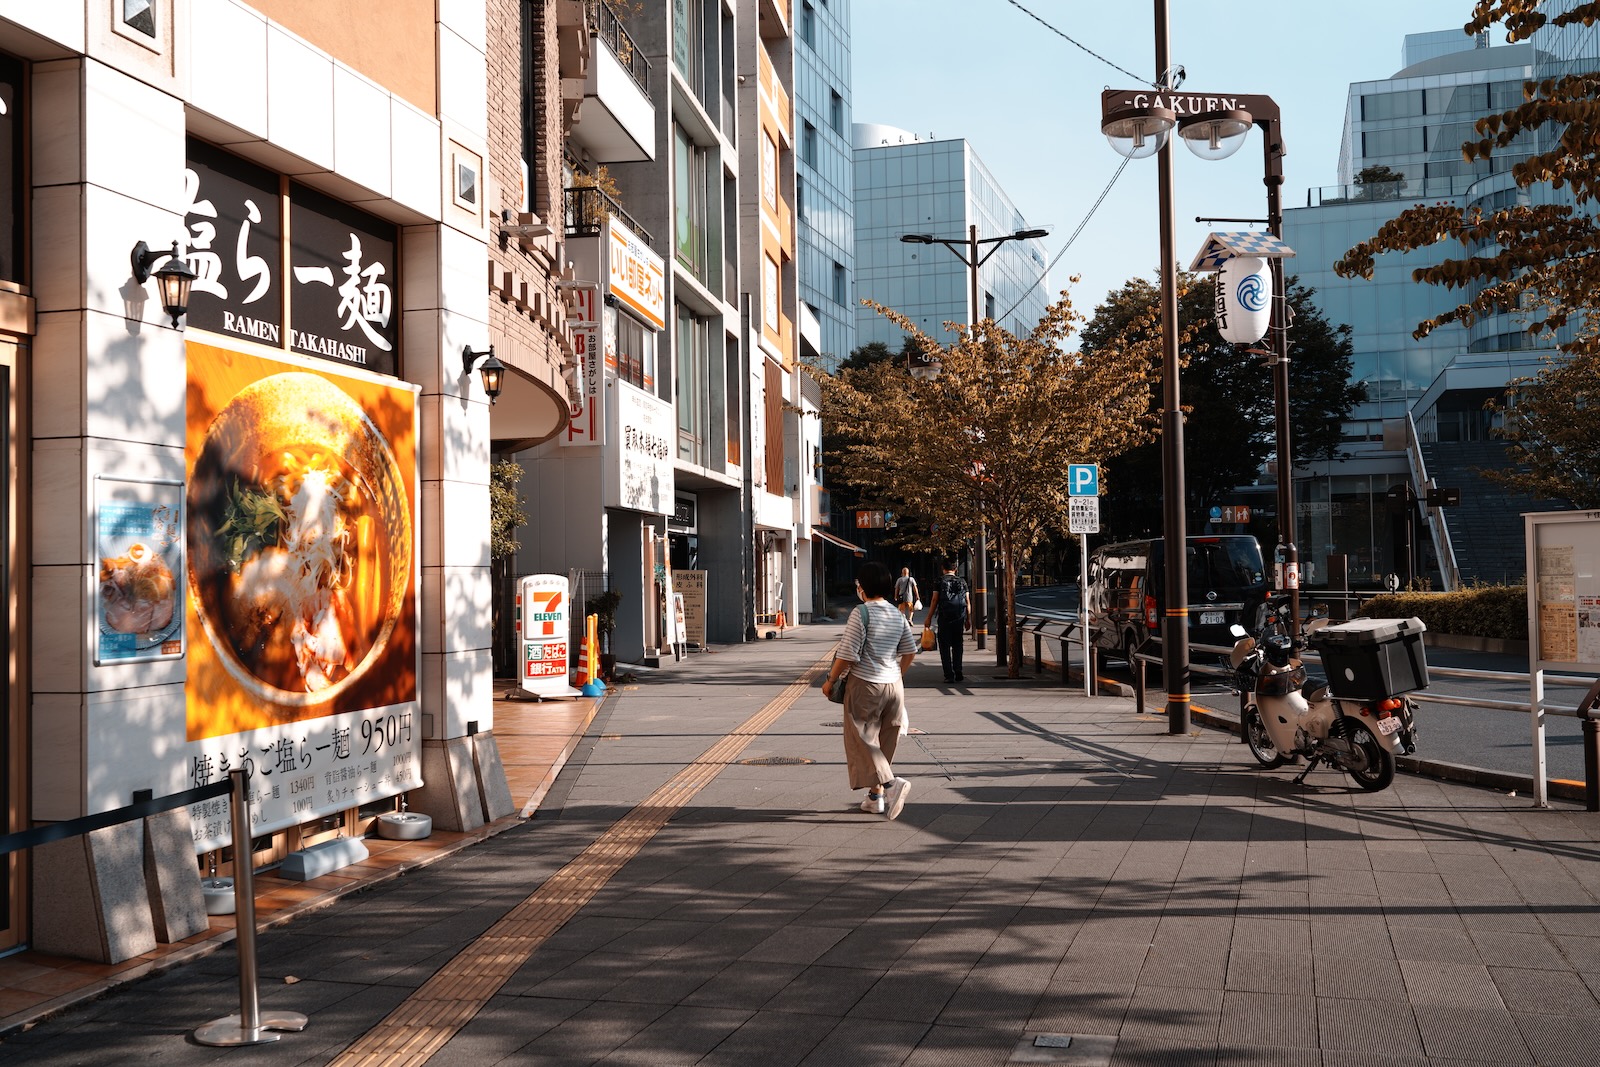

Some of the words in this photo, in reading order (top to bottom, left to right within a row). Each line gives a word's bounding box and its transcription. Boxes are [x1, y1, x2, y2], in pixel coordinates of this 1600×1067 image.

[610, 241, 663, 309] いい部屋ネット
[223, 311, 280, 343] RAMEN
[289, 328, 367, 365] TAKAHASHI
[588, 334, 597, 395] お部屋さがしは
[1076, 467, 1093, 493] P
[533, 591, 562, 635] 7
[528, 645, 542, 660] 酒
[543, 643, 566, 660] たばこ
[190, 726, 350, 788] 焼きあご塩らー麺
[361, 713, 412, 756] 950円
[393, 751, 412, 766] 1000円
[290, 776, 315, 796] 1340円
[293, 797, 314, 814] 100円
